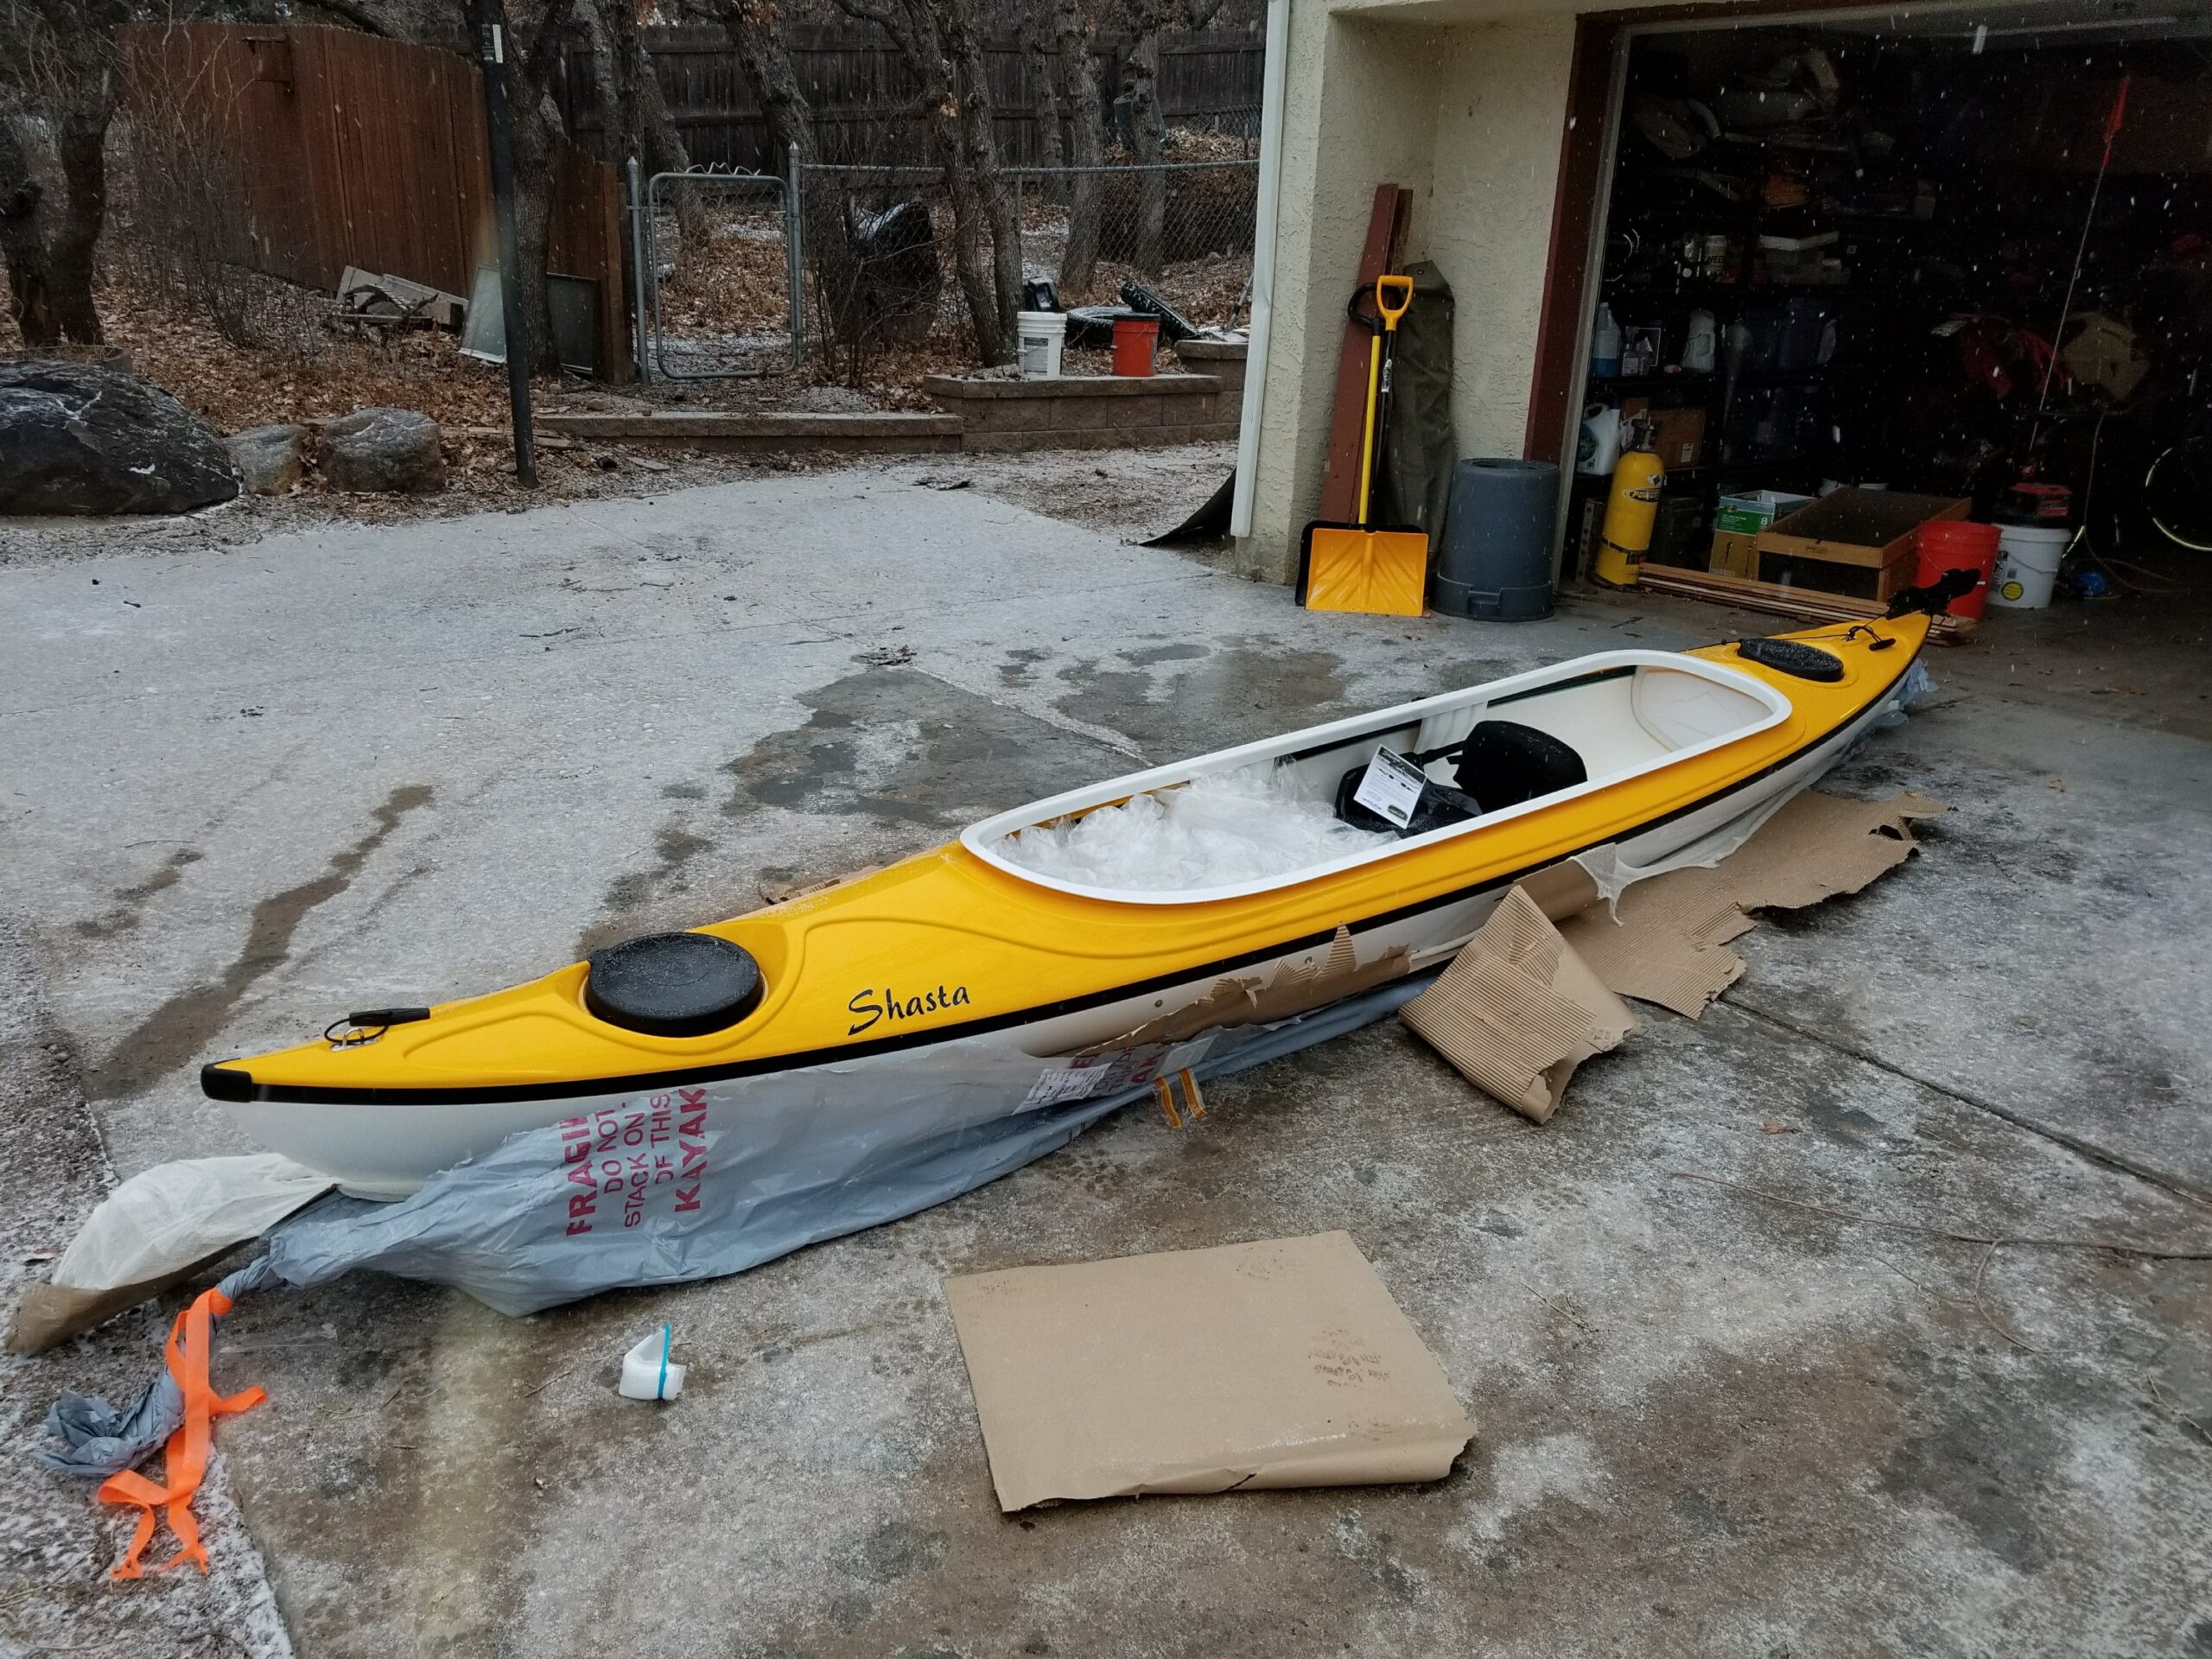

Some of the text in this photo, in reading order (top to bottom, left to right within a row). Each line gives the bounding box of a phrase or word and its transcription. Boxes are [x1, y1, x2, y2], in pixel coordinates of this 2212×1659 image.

[1760, 517, 1769, 525] 8
[848, 985, 970, 1036] Shasta
[594, 1109, 624, 1194] DO NOT
[650, 1093, 671, 1148] THIS
[675, 1089, 707, 1211] KAYAK
[624, 1113, 649, 1227] STACK ON
